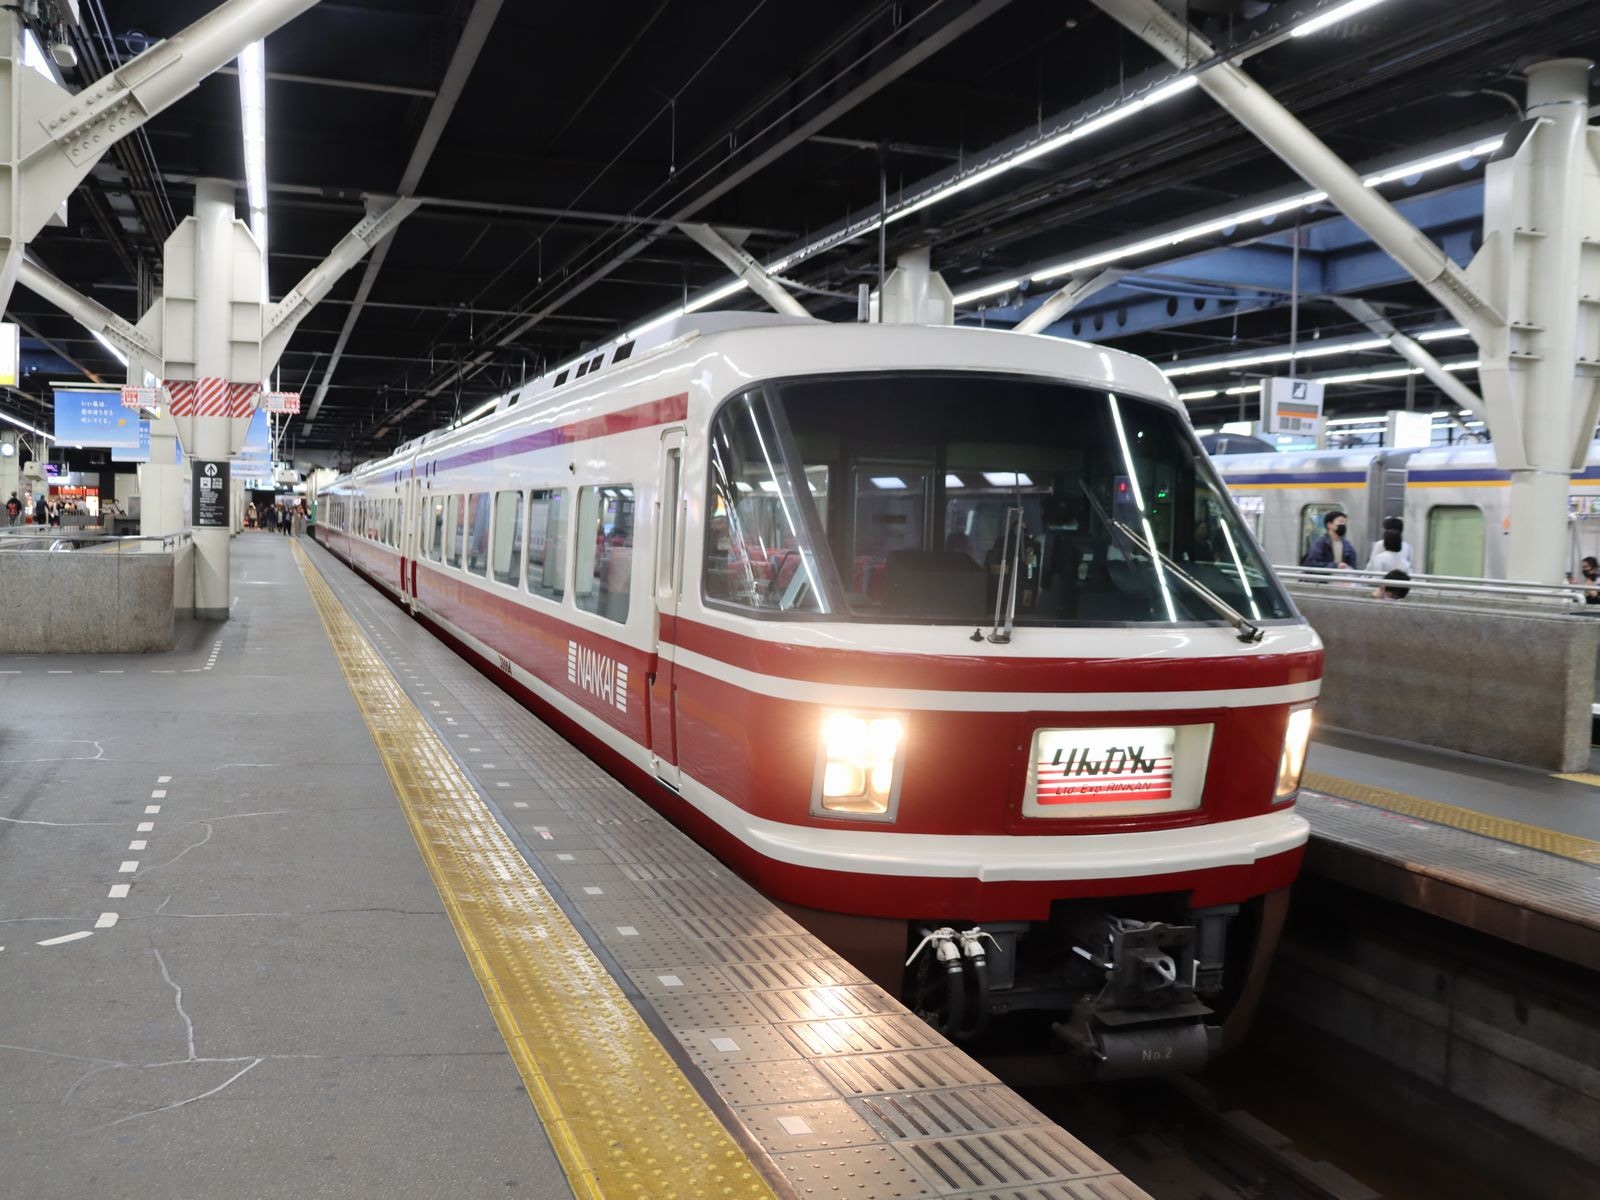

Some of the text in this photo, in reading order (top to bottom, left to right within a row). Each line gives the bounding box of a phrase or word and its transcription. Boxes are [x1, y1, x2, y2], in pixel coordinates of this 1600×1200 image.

[577, 644, 615, 705] NANKAI
[1051, 746, 1156, 776] りんかん
[1106, 782, 1152, 792] RINKAN
